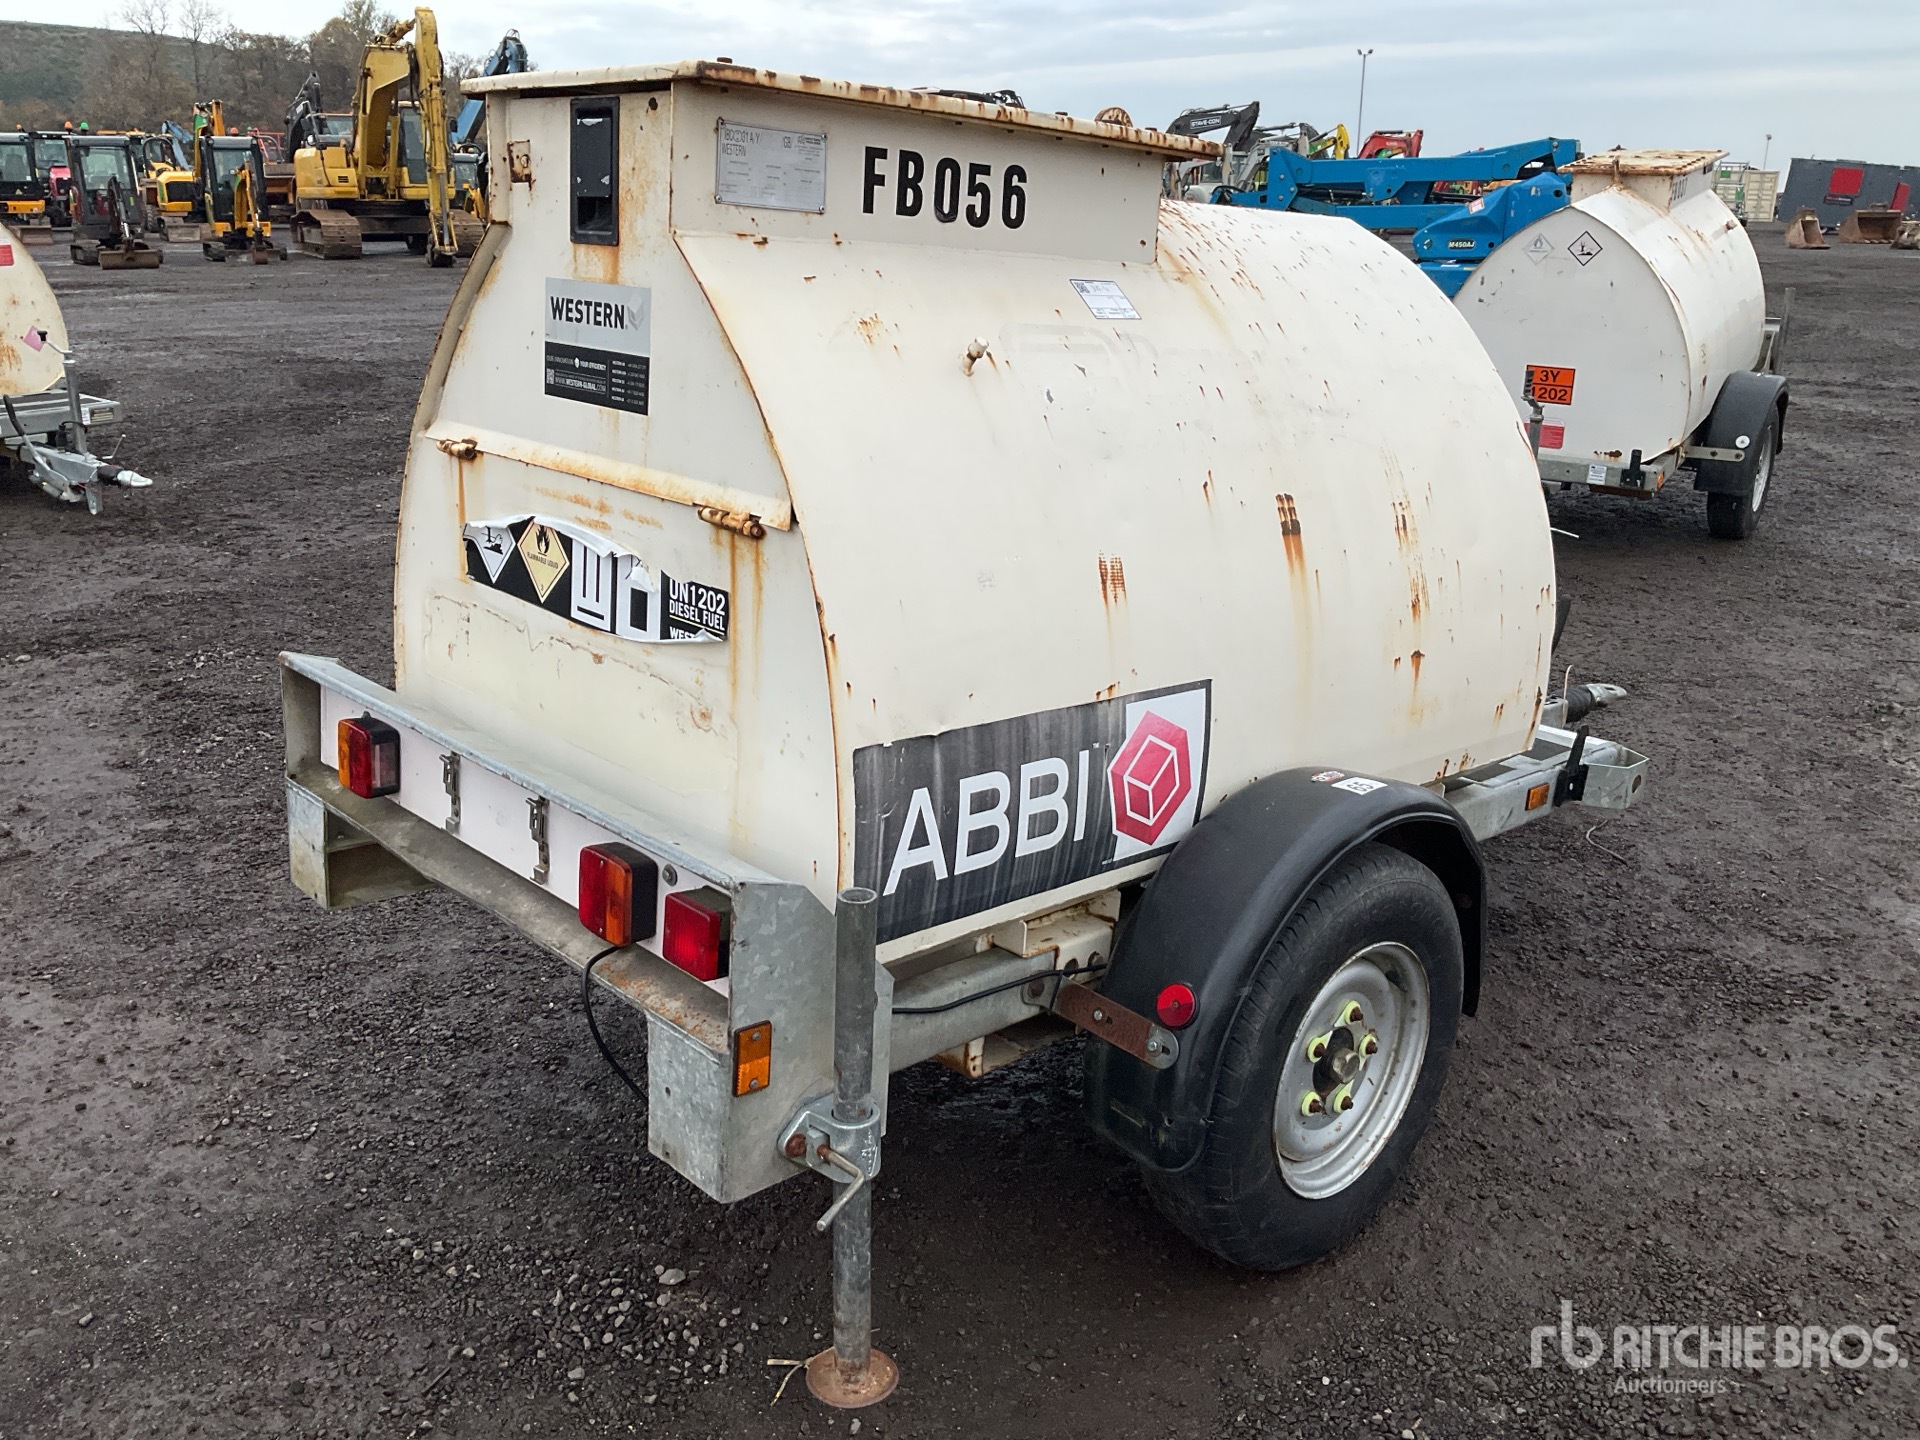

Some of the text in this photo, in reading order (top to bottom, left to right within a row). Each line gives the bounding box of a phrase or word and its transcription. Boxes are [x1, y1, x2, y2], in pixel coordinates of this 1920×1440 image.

[862, 146, 1027, 229] FB056
[1448, 241, 1475, 249] M450AJ
[550, 295, 625, 330] WESTERN
[1539, 369, 1561, 383] 3Y
[1531, 386, 1568, 402] 1202
[526, 551, 548, 565] FLAMMABLE
[669, 578, 726, 616] UN1202
[669, 600, 726, 632] DIESEL FUEL
[882, 749, 1090, 897] ABBI
